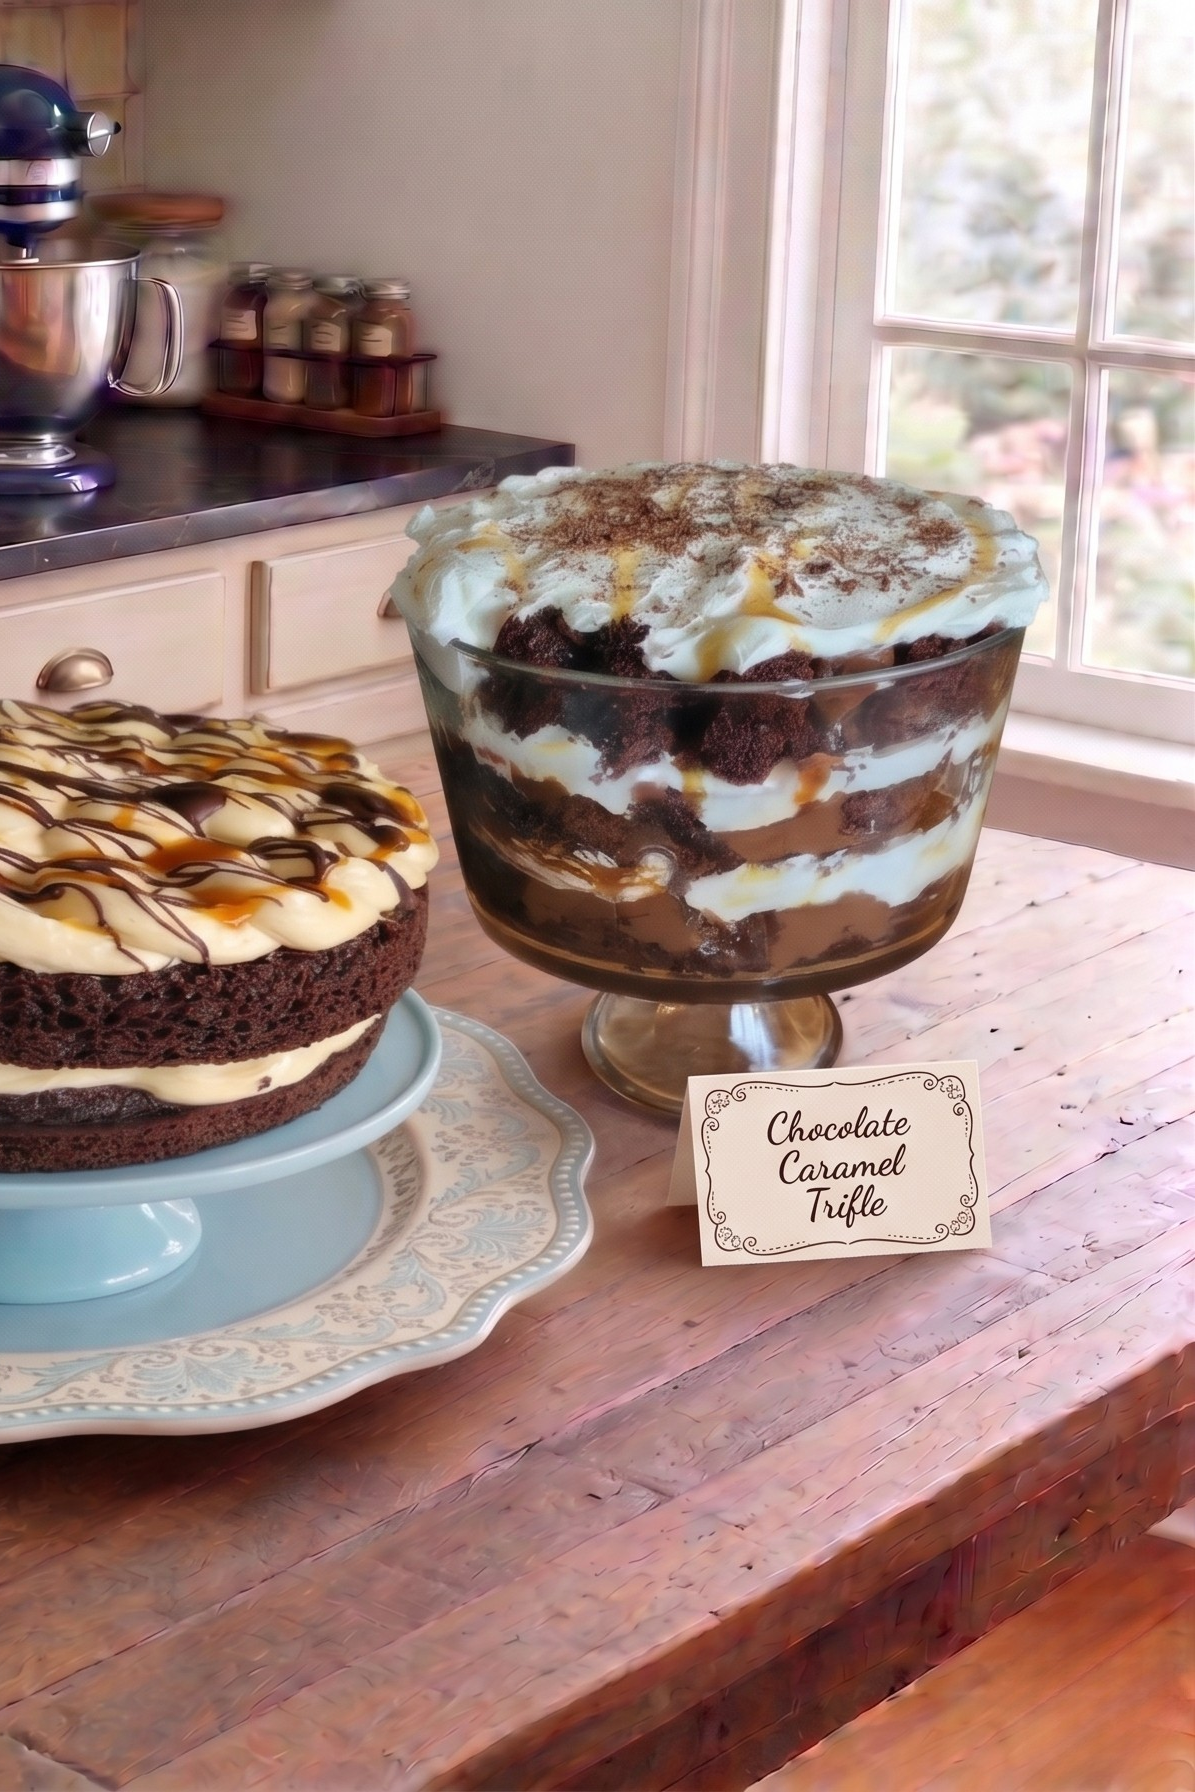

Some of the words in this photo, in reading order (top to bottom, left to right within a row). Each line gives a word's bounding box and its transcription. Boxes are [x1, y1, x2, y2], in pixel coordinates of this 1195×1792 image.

[767, 1105, 912, 1146] Chocolate
[778, 1143, 907, 1185] Caramel
[806, 1183, 888, 1229] Trifle
